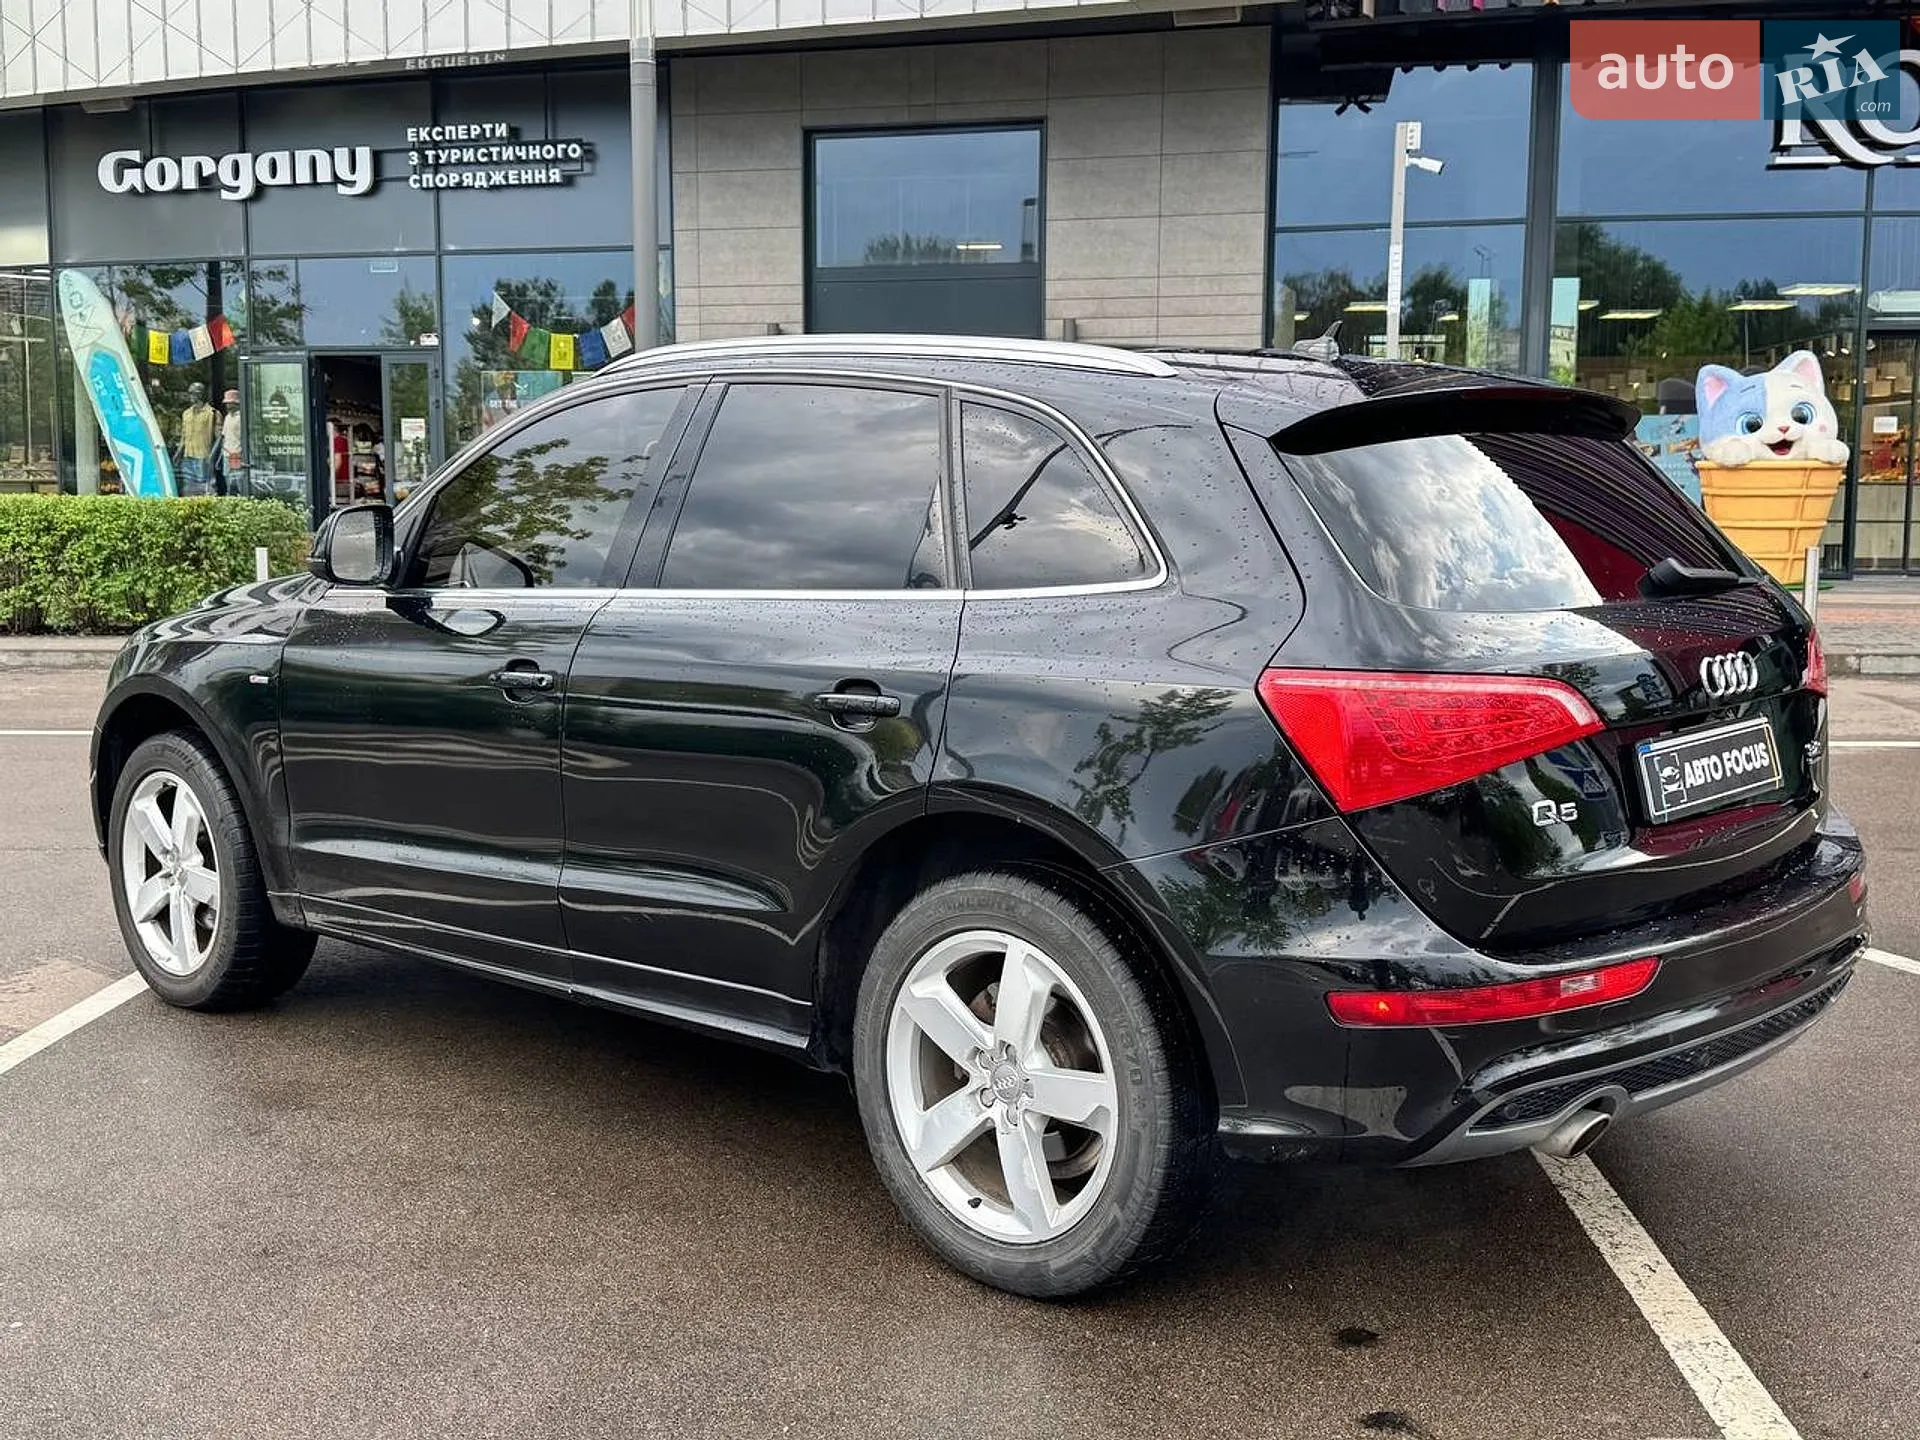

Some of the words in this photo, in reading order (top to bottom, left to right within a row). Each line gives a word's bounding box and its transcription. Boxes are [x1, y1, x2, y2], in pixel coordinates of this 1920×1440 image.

[407, 123, 508, 142] ЕКСПЕРТИ
[425, 143, 582, 165] ТУРИСТИЧНОГО
[97, 146, 374, 201] Gorgany
[409, 168, 563, 189] СПОРЯДЖЕННЯ
[1724, 742, 1770, 778] FOCUS
[1531, 800, 1578, 826] Q5
